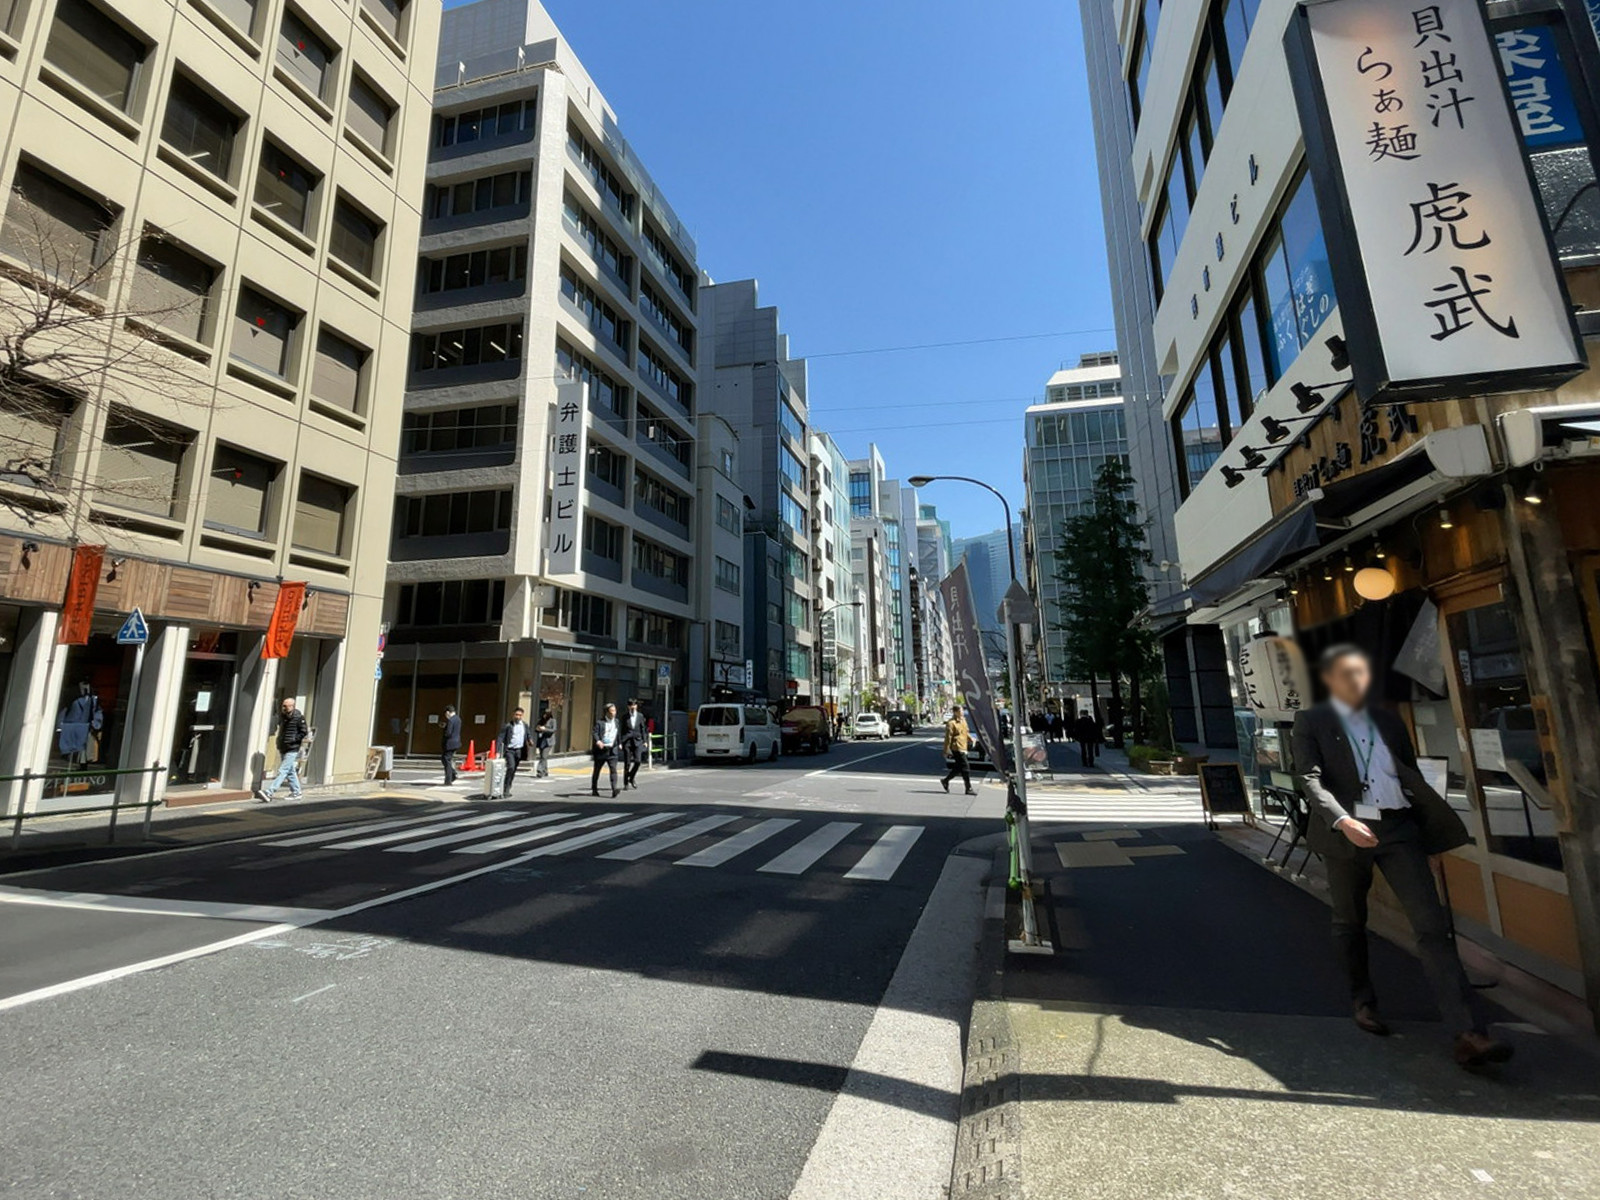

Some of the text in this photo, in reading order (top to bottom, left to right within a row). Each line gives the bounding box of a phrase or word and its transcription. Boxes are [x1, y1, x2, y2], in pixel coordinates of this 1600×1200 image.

[1356, 46, 1422, 163] らぁ麺
[1411, 5, 1476, 130] 貝出汁
[1403, 182, 1520, 342] 虎武
[553, 402, 579, 554] 弁護士ビル
